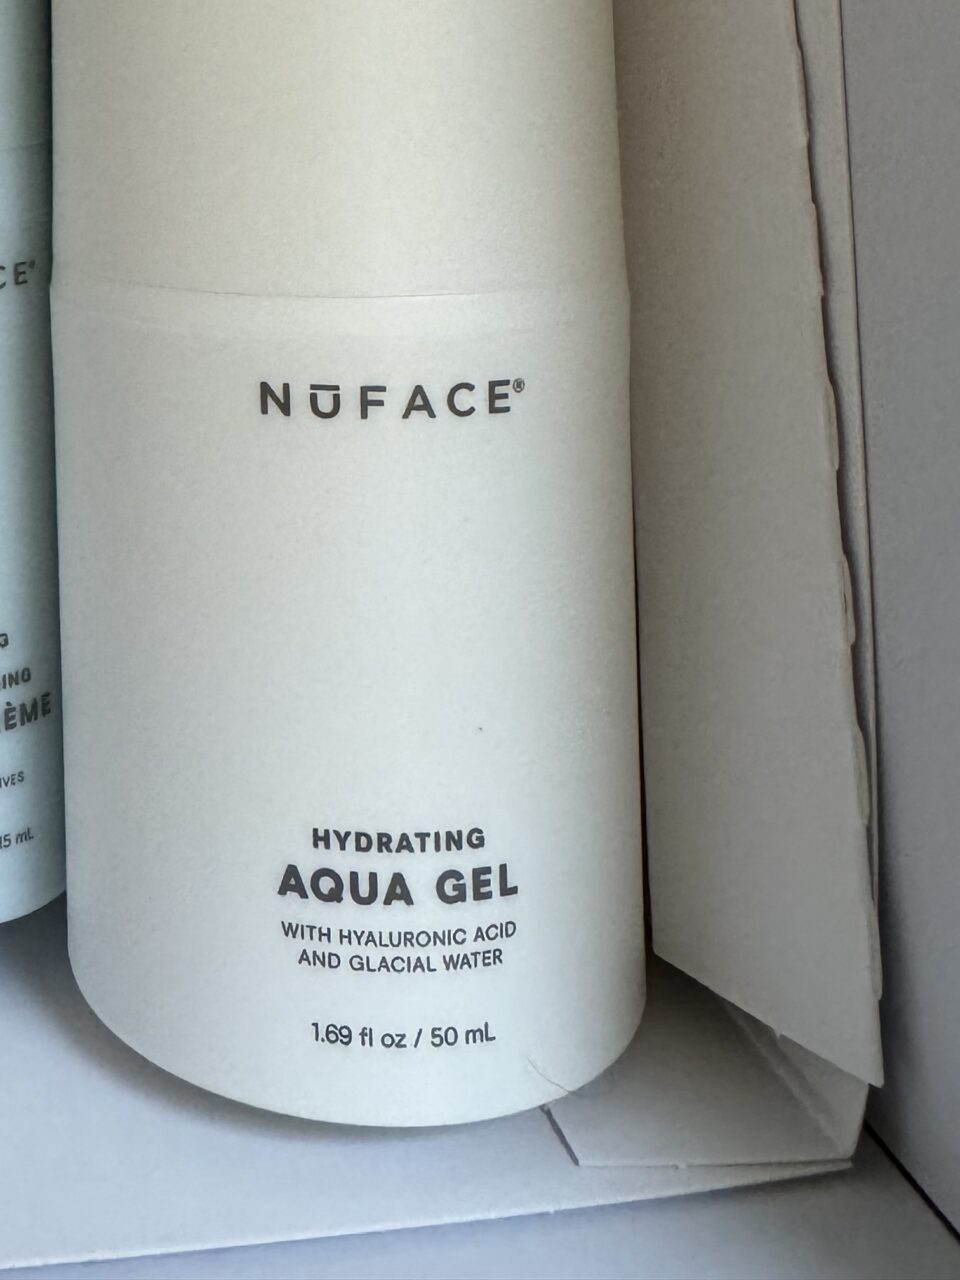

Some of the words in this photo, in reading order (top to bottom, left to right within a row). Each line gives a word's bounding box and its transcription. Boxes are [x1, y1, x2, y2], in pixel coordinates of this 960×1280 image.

[16, 828, 34, 844] mL
[312, 827, 485, 853] HYDRATING
[277, 864, 414, 907] AQUA
[435, 863, 518, 905] GEL
[281, 921, 331, 944] WITH
[339, 928, 467, 948] HYALURONIC
[473, 921, 516, 942] ACID
[298, 949, 341, 969] AND
[349, 955, 437, 974] GLACIAL
[443, 948, 503, 972] WATER
[311, 1022, 352, 1047] 1.69
[359, 1027, 373, 1047] fl
[381, 1033, 407, 1049] oz
[414, 1028, 423, 1048] /
[431, 1026, 458, 1048] 50
[465, 1022, 496, 1045] mL
